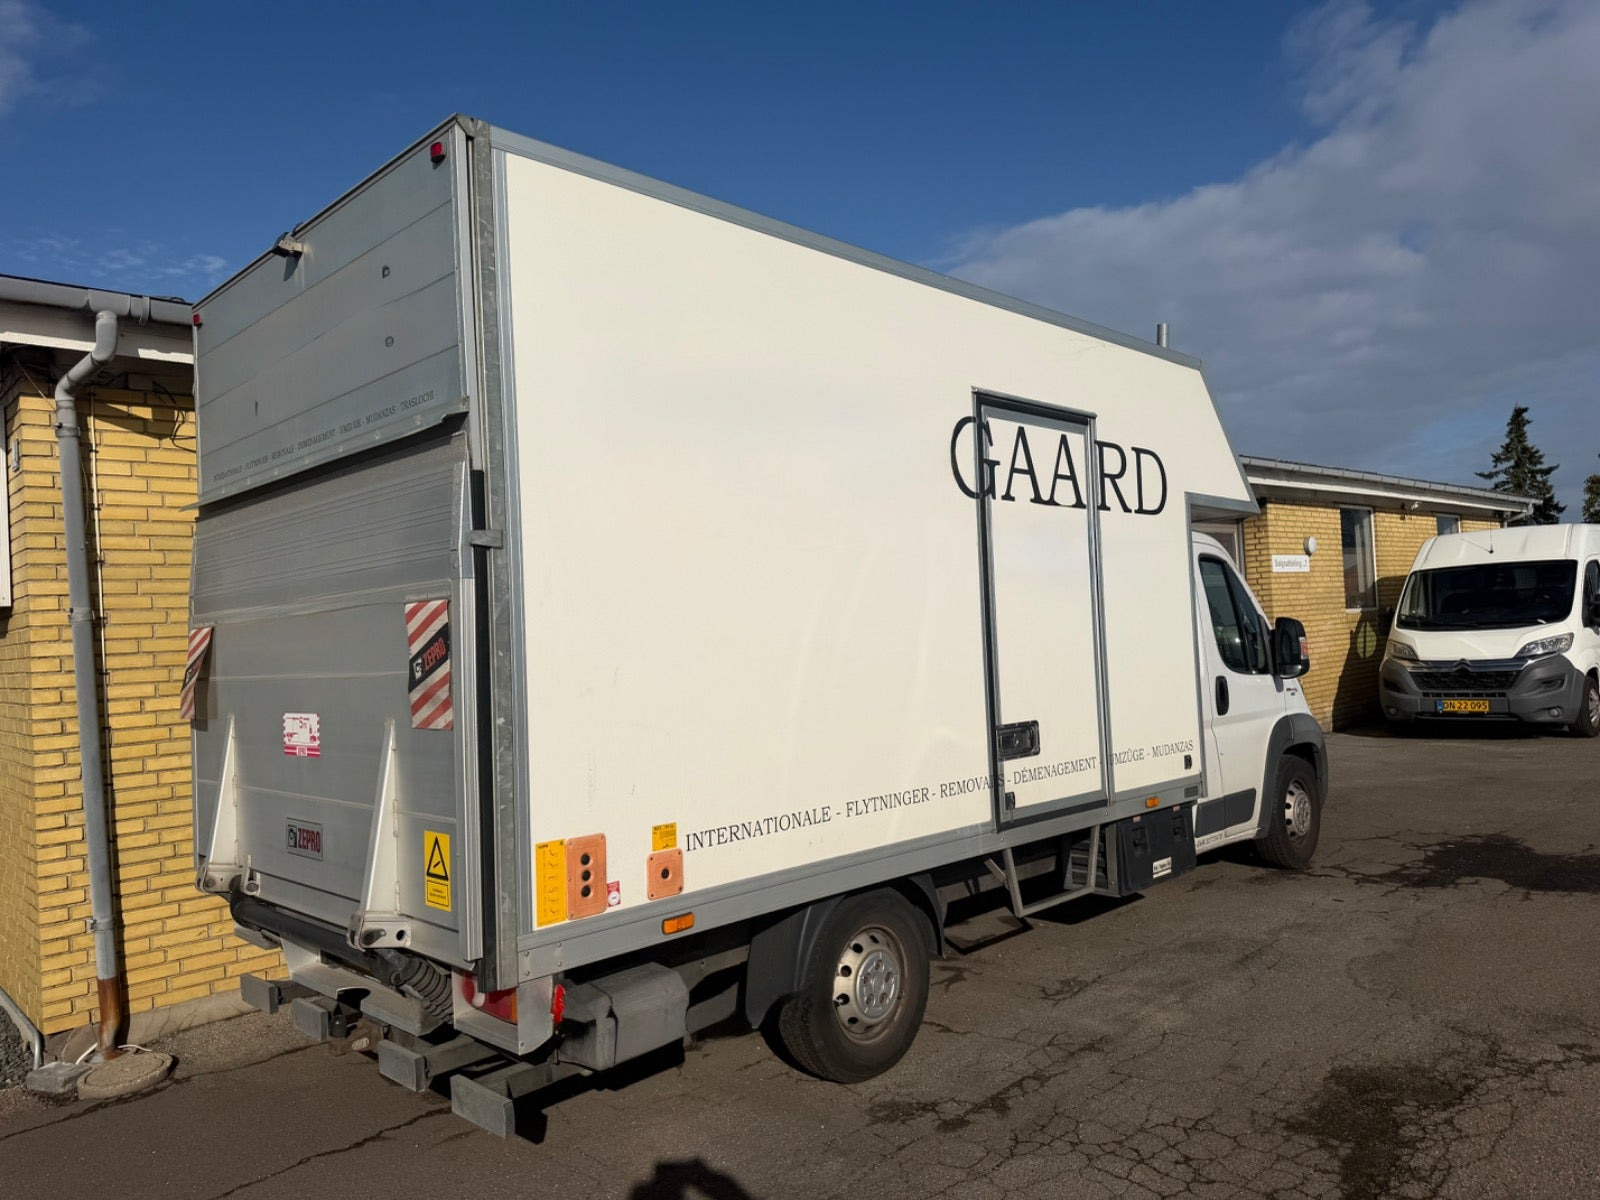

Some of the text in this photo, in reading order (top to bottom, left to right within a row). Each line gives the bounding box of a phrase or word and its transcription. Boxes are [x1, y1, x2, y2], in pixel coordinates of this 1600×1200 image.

[951, 416, 1167, 515] GAARD
[423, 637, 447, 671] ZEPRO
[686, 806, 831, 851] INTERNATIONALE
[846, 787, 929, 818] FLYTNINGER
[940, 773, 1004, 798] REMOVAS
[1152, 740, 1193, 758] MUDANZAS
[298, 828, 321, 853] ZEPRO
